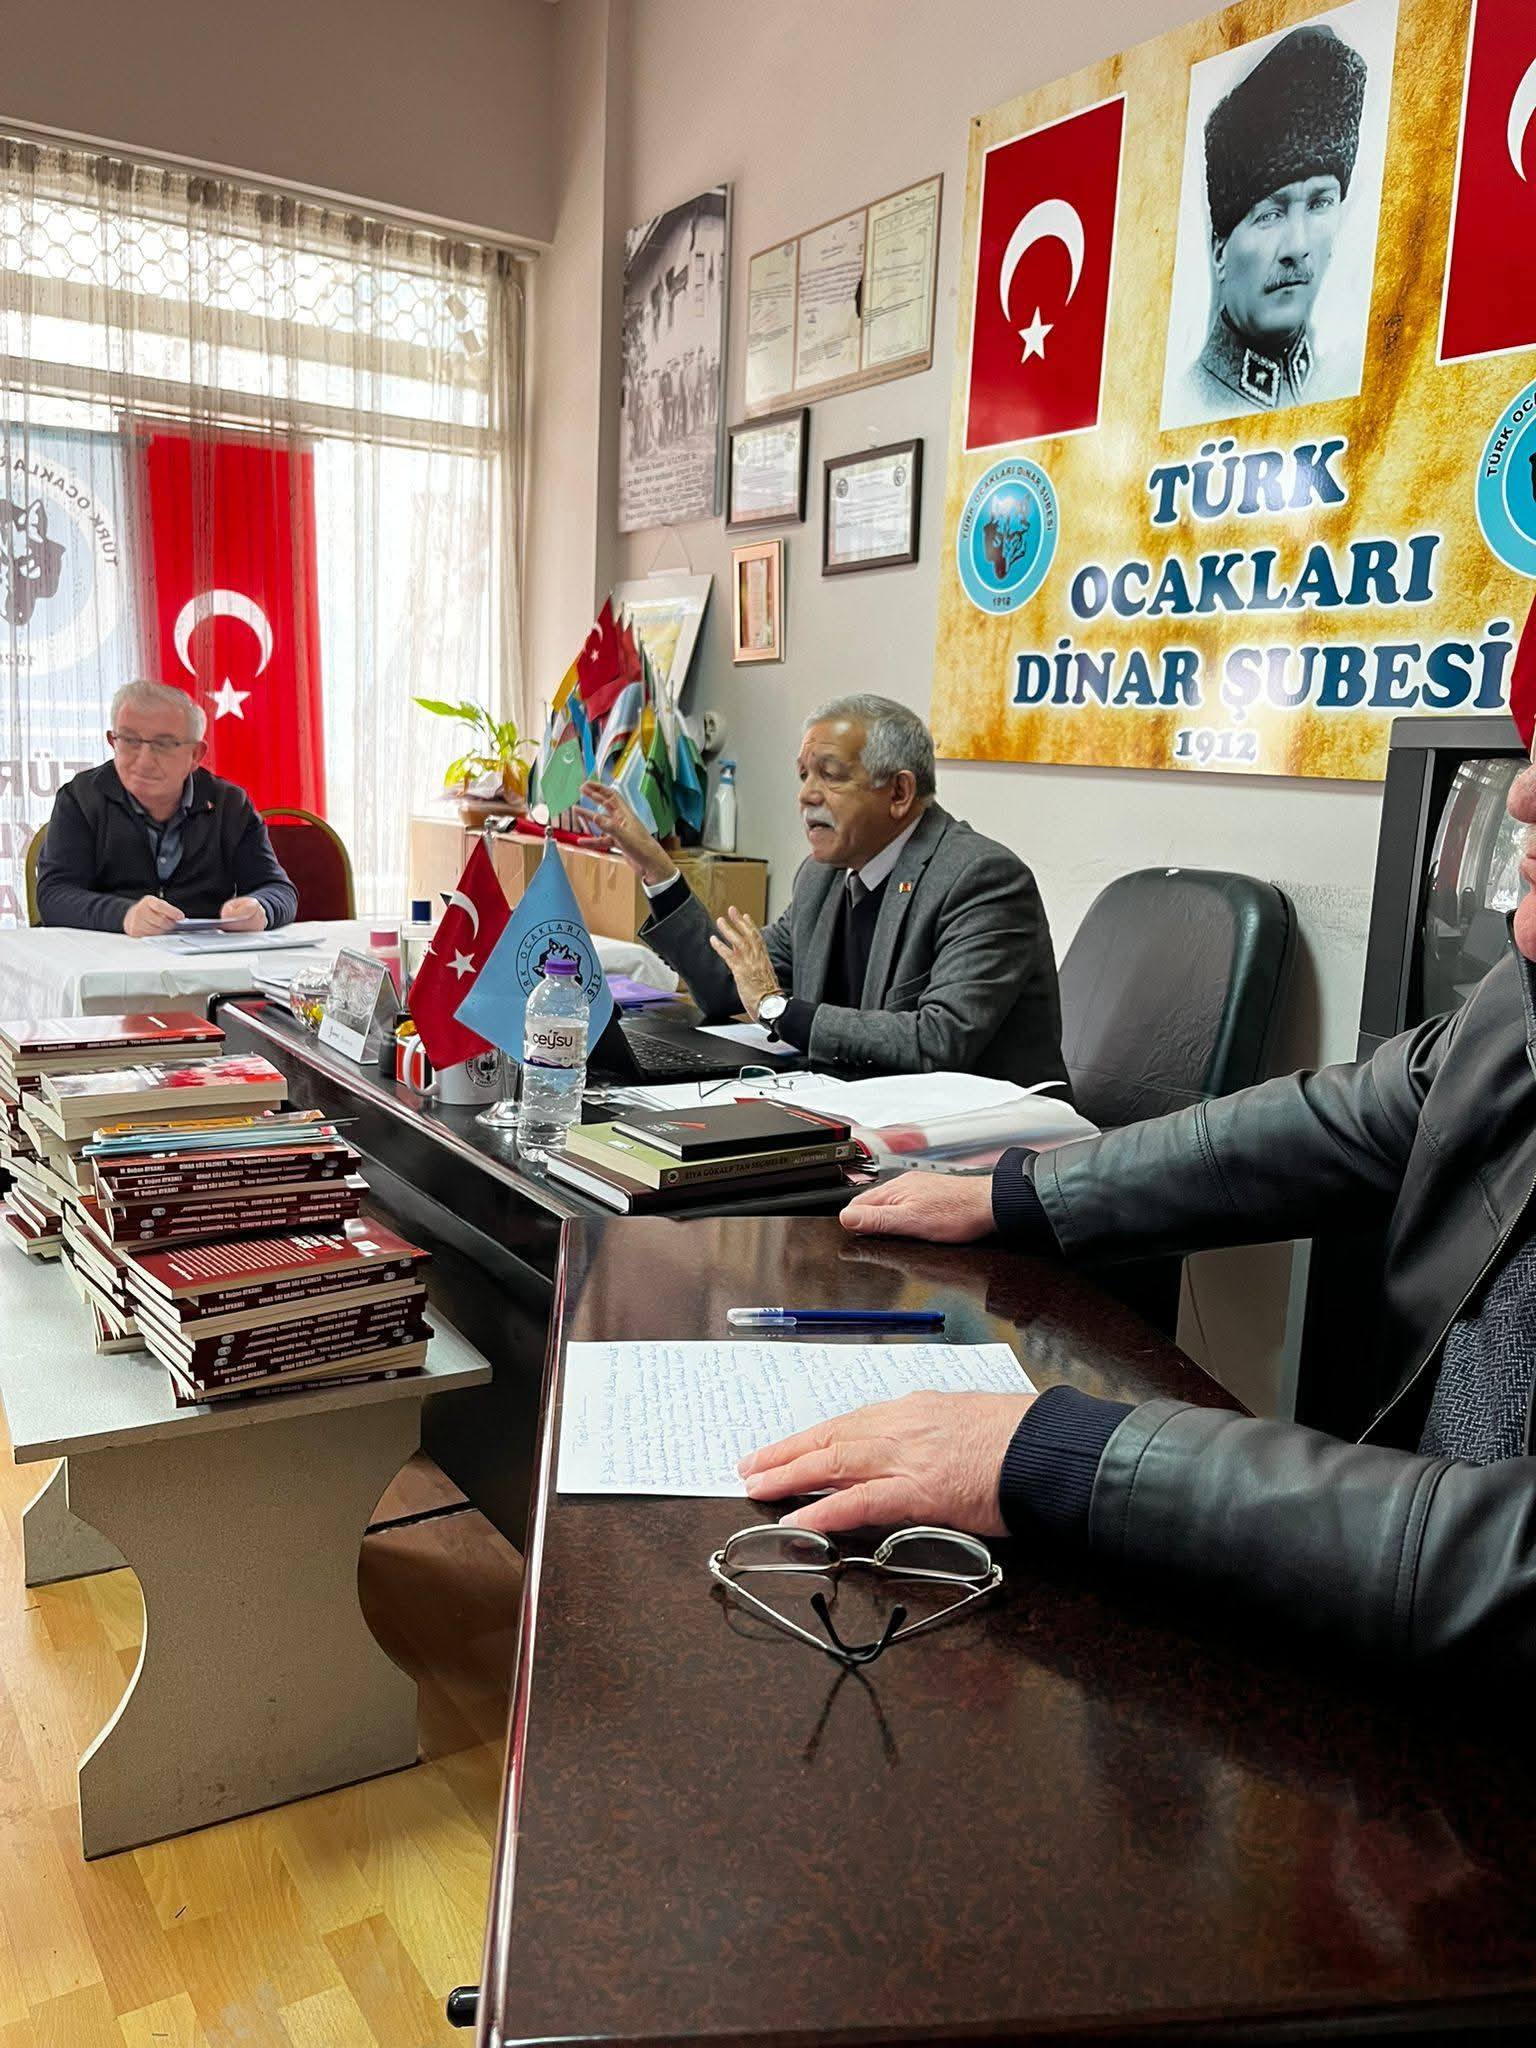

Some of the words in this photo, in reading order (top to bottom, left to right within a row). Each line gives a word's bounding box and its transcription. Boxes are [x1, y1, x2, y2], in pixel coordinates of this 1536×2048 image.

[1487, 425, 1514, 478] TÜRK
[1512, 391, 1536, 424] OC
[974, 466, 1015, 503] OCAKLARI
[1149, 440, 1346, 524] TÜRK
[1071, 535, 1440, 616] OCAKLARI
[1012, 638, 1202, 705] DİNAR
[1221, 621, 1513, 720] ŞUBESİ
[1175, 729, 1257, 761] 1912
[520, 923, 582, 960] OCAKLARI
